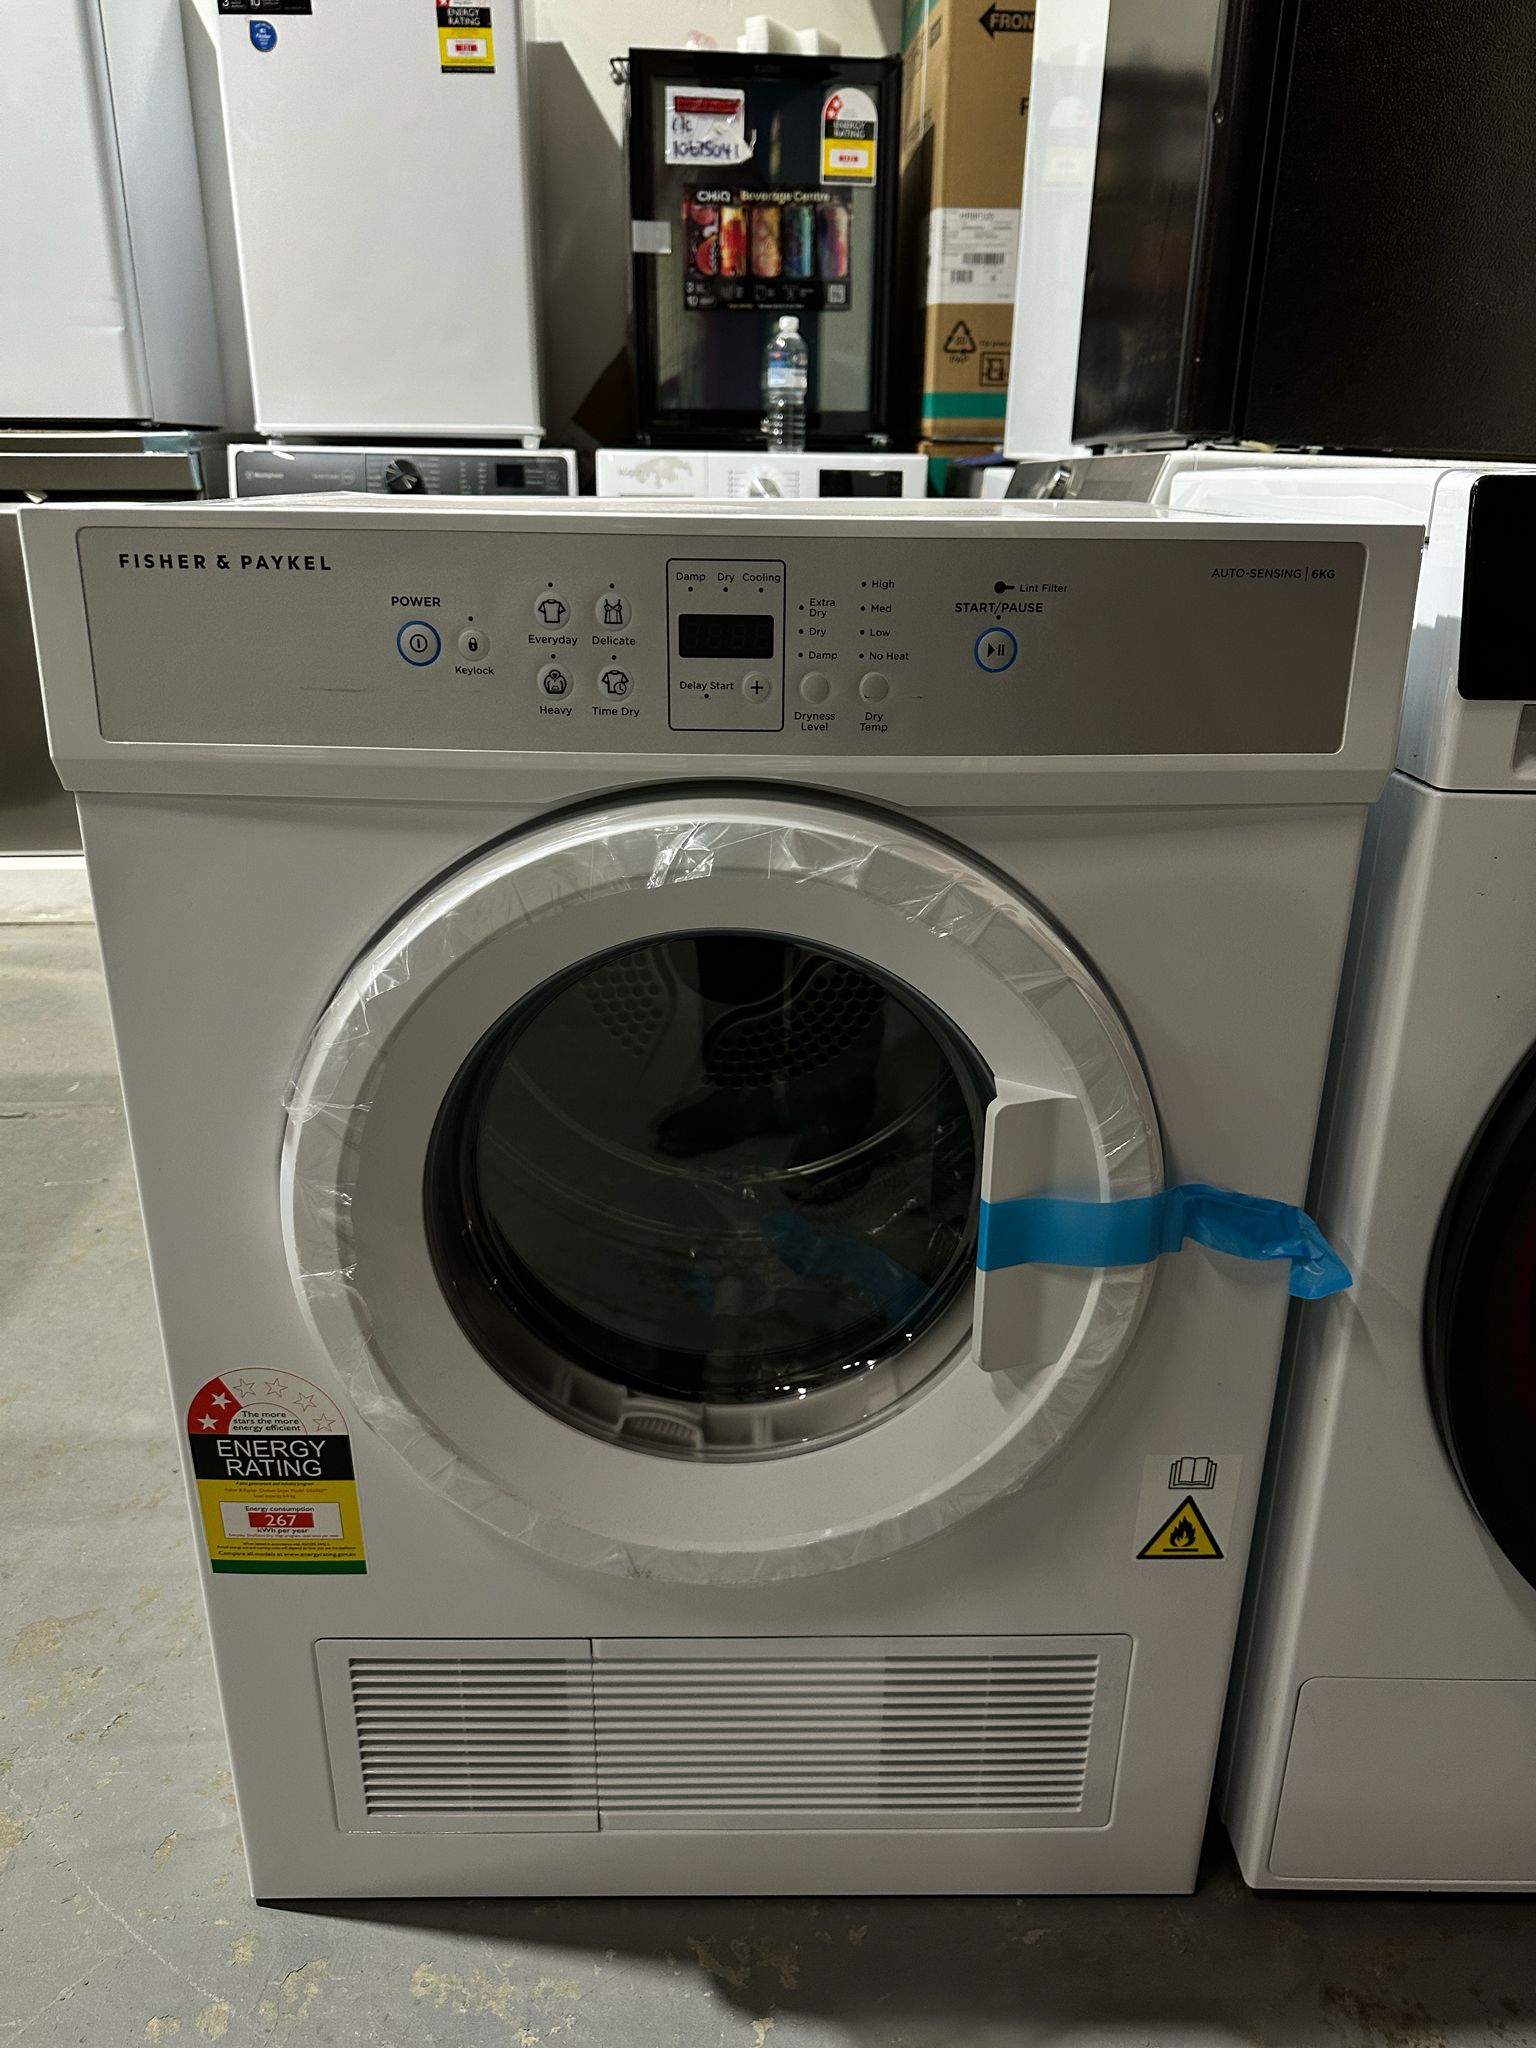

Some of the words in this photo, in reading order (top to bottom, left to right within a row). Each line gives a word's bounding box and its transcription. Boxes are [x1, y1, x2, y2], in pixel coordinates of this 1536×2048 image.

[447, 8, 480, 17] ENERGY
[448, 17, 481, 26] RATING
[990, 13, 1035, 30] FRON
[740, 190, 791, 205] Beverage
[793, 191, 830, 201] Centre
[119, 553, 207, 569] FISHER
[216, 554, 231, 570] &
[240, 554, 332, 571] PAYKEL
[676, 572, 706, 582] Damp
[717, 572, 735, 583] Dry
[742, 572, 781, 583] Cooling
[1211, 568, 1301, 579] AUTO-SENSING
[1311, 569, 1335, 579] 6KG
[871, 579, 895, 590] High
[1020, 583, 1039, 593] Lint
[1041, 583, 1068, 593] Filter
[391, 596, 441, 608] POWER
[809, 598, 836, 607] Extra
[870, 604, 892, 613] Med
[954, 601, 1044, 614] START/PAUSE
[809, 609, 827, 618] Dry
[808, 627, 827, 637] Dry
[869, 628, 891, 637] Low
[528, 635, 578, 646] Everyday
[592, 635, 636, 646] Delicate
[808, 651, 838, 661] Damp
[869, 652, 883, 661] No
[886, 652, 909, 661] Heat
[455, 666, 495, 676] Keylock
[679, 681, 708, 691] Delay
[710, 681, 734, 690] Start
[539, 705, 573, 716] Heavy
[592, 706, 618, 716] Time
[621, 706, 640, 718] Dry
[794, 712, 836, 722] Dryness
[865, 712, 884, 722] Dry
[801, 722, 829, 731] Level
[859, 723, 888, 733] Temp
[241, 1410, 260, 1418] The
[216, 1439, 326, 1458] ENERGY
[226, 1459, 322, 1477] RATING
[264, 1514, 297, 1526] 267
